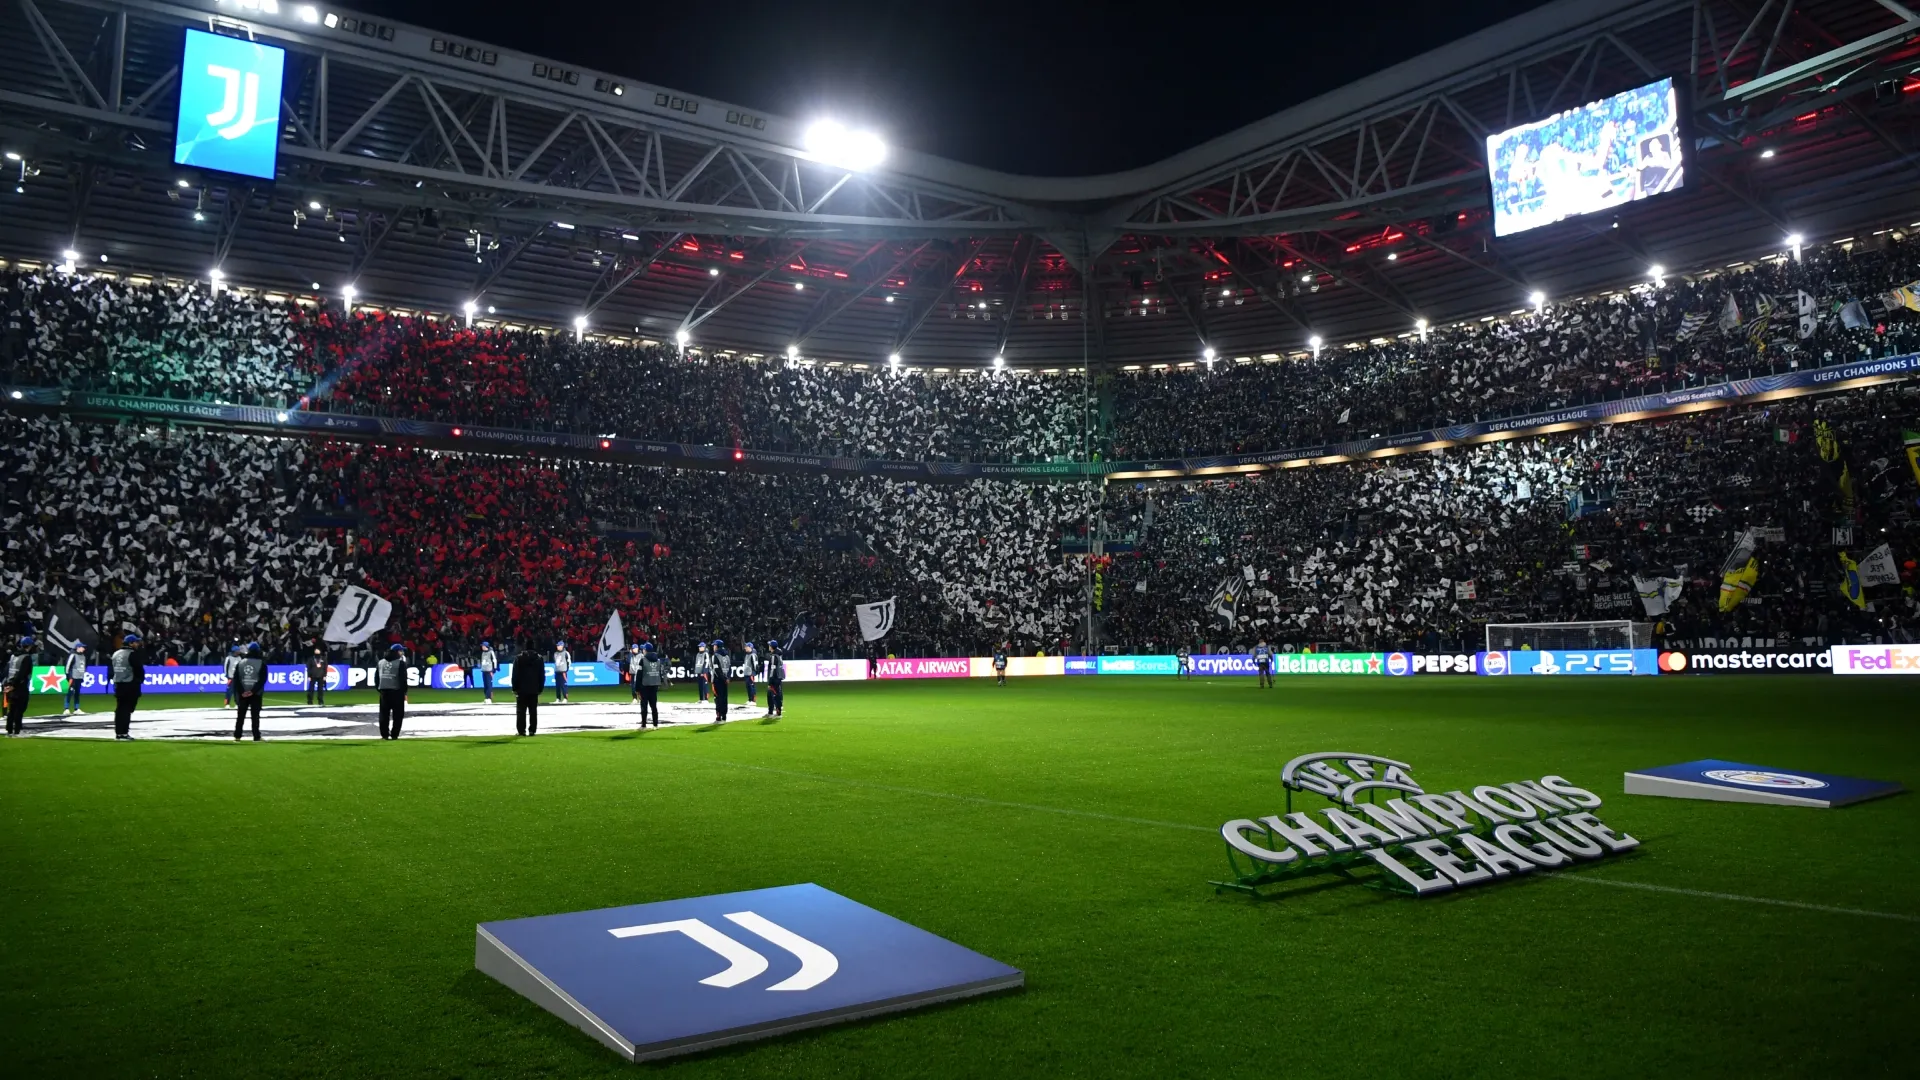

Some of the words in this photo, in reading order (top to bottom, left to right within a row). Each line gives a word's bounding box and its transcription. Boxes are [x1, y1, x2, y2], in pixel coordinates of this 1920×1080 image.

[1813, 370, 1841, 382] UEFA
[1843, 360, 1907, 377] CHAMPIONS
[87, 397, 115, 407] UEFA
[118, 399, 180, 413] CHAMPIONS
[183, 405, 222, 416] LEAGUE
[336, 419, 358, 427] PS5
[1489, 422, 1509, 431] UEFA
[1510, 415, 1555, 429] CHAMPIONS
[1557, 410, 1588, 422] LEAGUE
[476, 429, 524, 441] CHAMPIONS
[526, 435, 557, 444] LEAGUE
[1393, 436, 1423, 445] crypto.com
[756, 454, 795, 464] CHAMPIONS
[1238, 456, 1257, 464] UEFA
[1258, 452, 1297, 462] CHAMPIONS
[1298, 449, 1324, 458] LEAGUE
[1277, 655, 1364, 673] Heineken
[1412, 655, 1476, 673] PEPSI
[1565, 653, 1633, 672] PS5
[1691, 649, 1833, 669] mastercard
[1849, 649, 1920, 670] FedEx
[348, 667, 432, 687] PSI
[871, 662, 912, 677] QATAR
[917, 661, 968, 674] AIRWAYS
[143, 673, 229, 685] CHAMPIONS
[1296, 758, 1421, 797] UEFA
[1220, 775, 1602, 864] CHAMPIONS
[1364, 811, 1640, 893] LEAGUE
